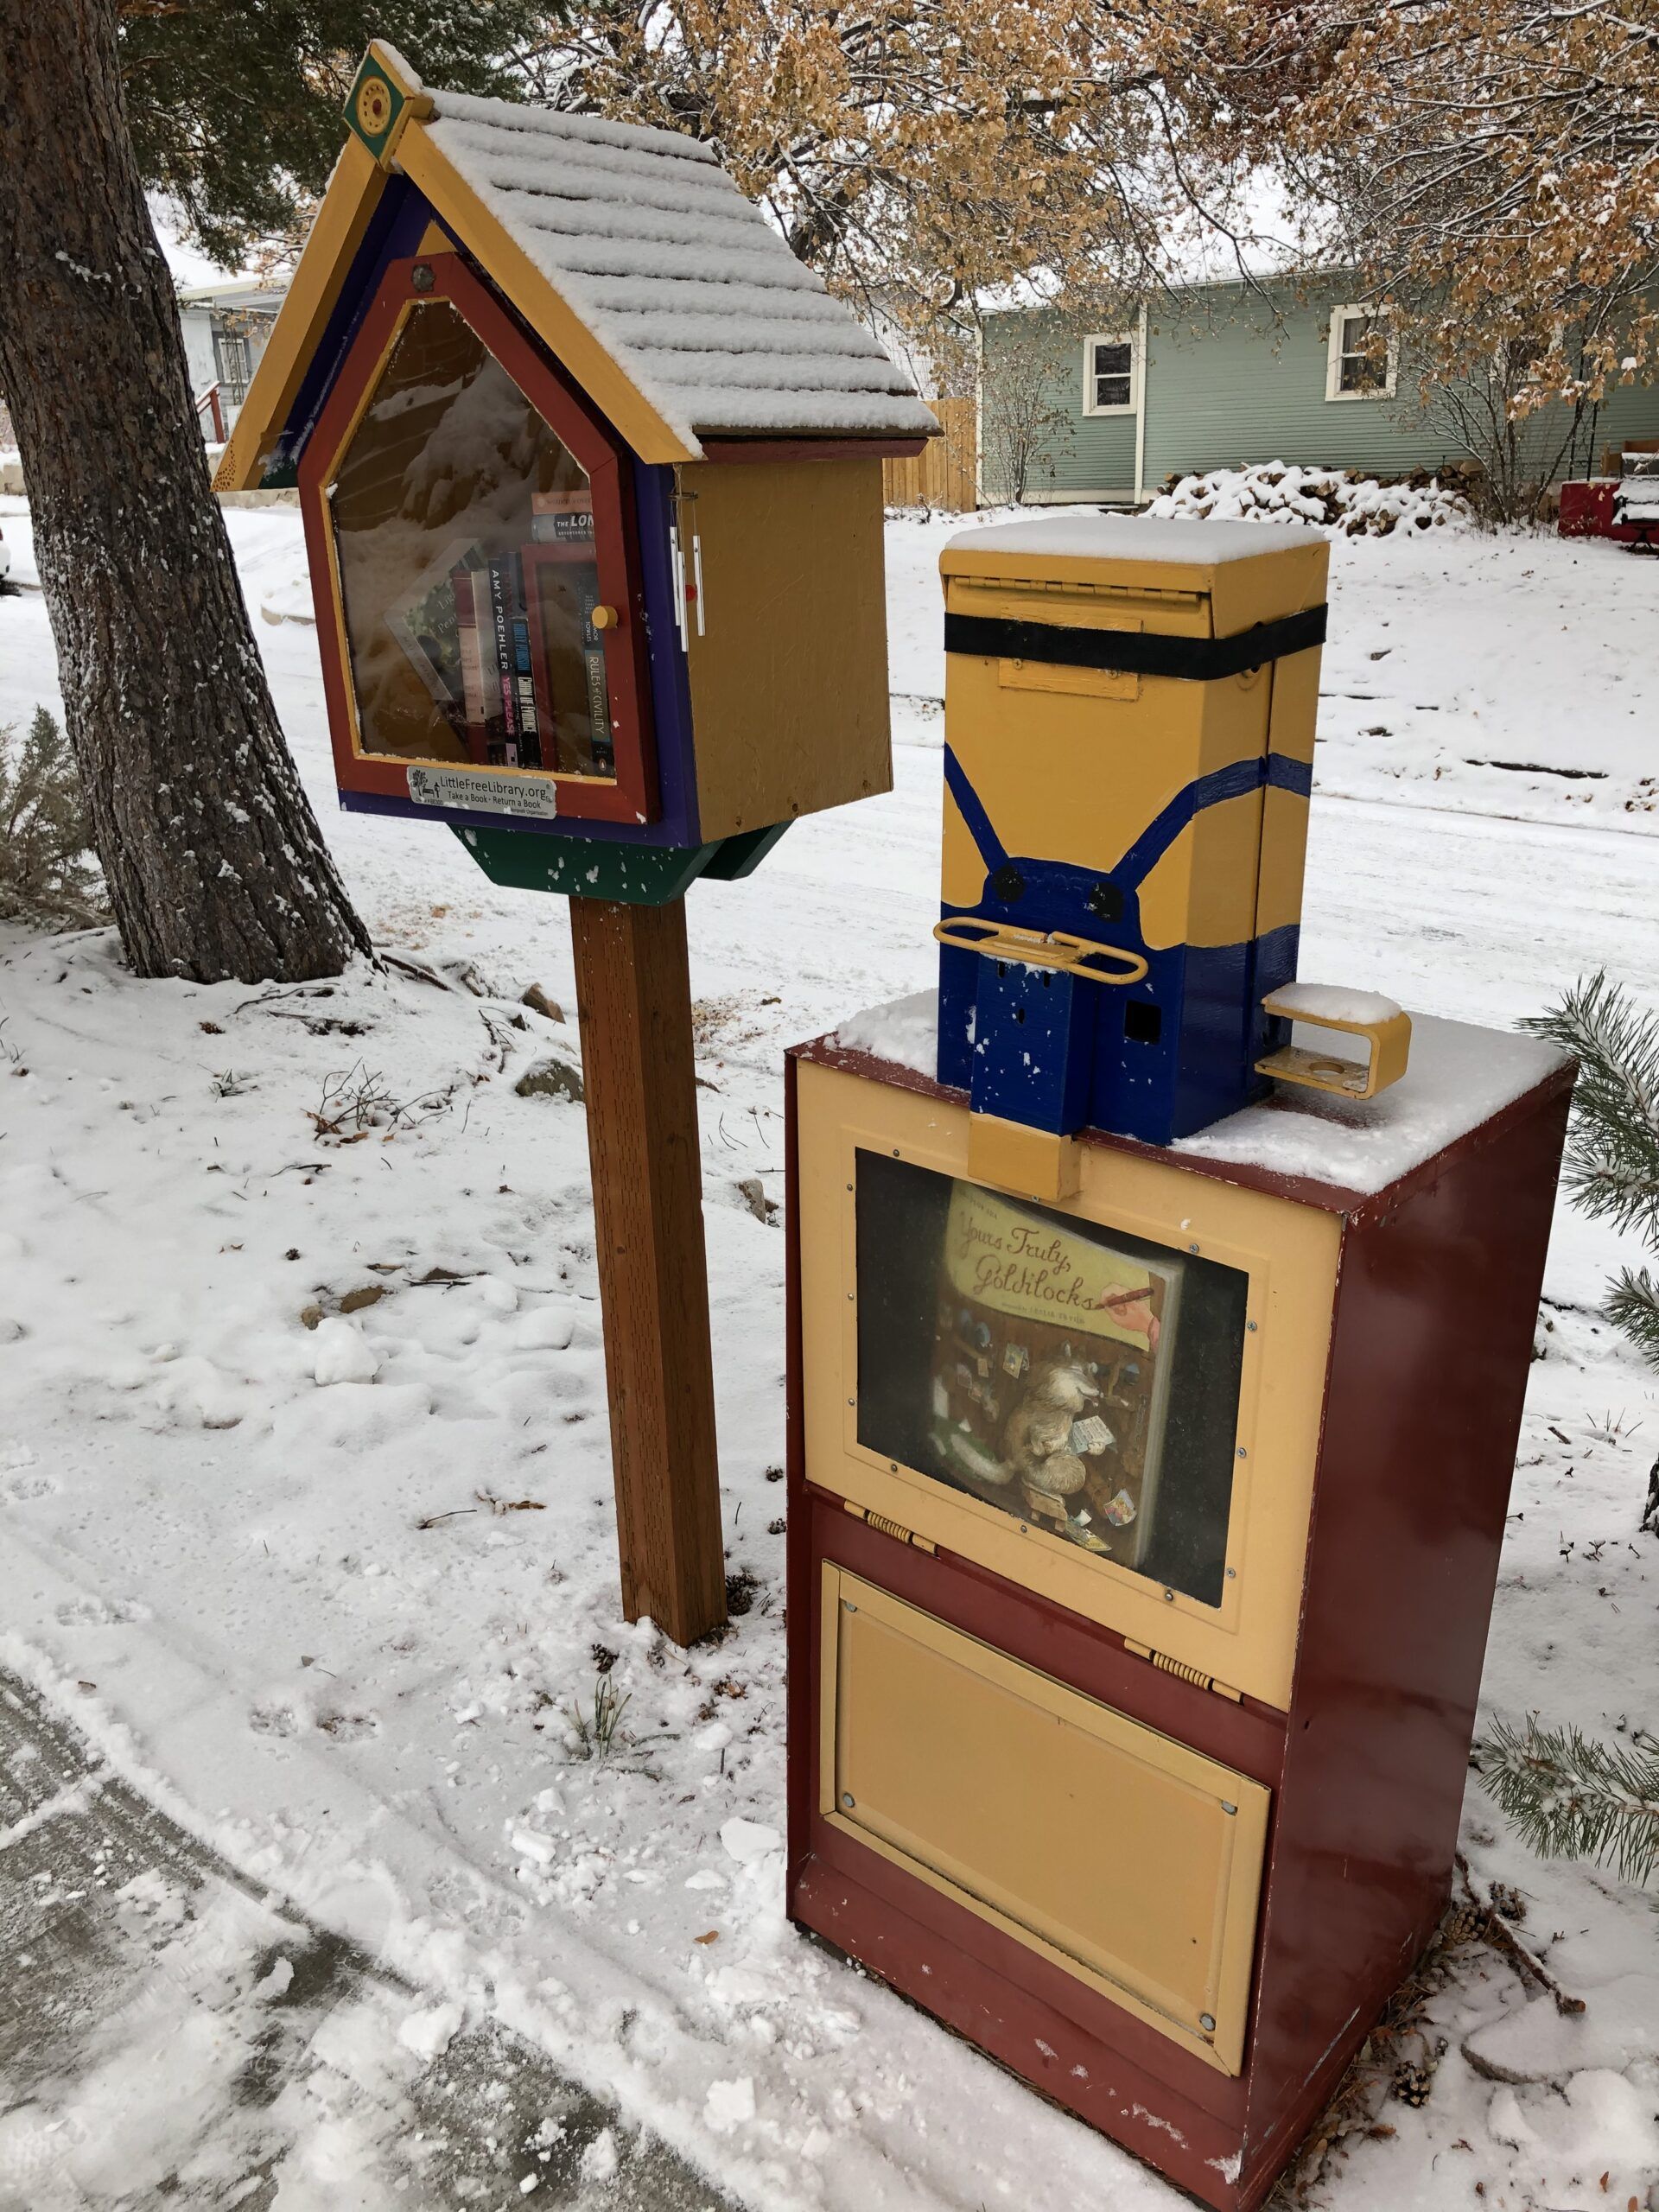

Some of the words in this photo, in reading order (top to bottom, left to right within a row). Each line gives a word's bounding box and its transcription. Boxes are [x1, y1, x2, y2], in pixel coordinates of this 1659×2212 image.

[492, 569, 502, 600] AMY
[495, 606, 509, 671] POEHLER
[502, 677, 512, 696] YES
[589, 657, 601, 686] RULES
[505, 696, 516, 736] PLEASE
[593, 695, 605, 734] CIVILITY
[448, 791, 464, 801] Take
[471, 793, 487, 804] Book
[493, 798, 516, 807] Return
[523, 799, 541, 810] Book
[959, 1211, 1002, 1261] Yours
[1007, 1227, 1071, 1275] Truly,
[972, 1254, 1096, 1310] Goldilocks
